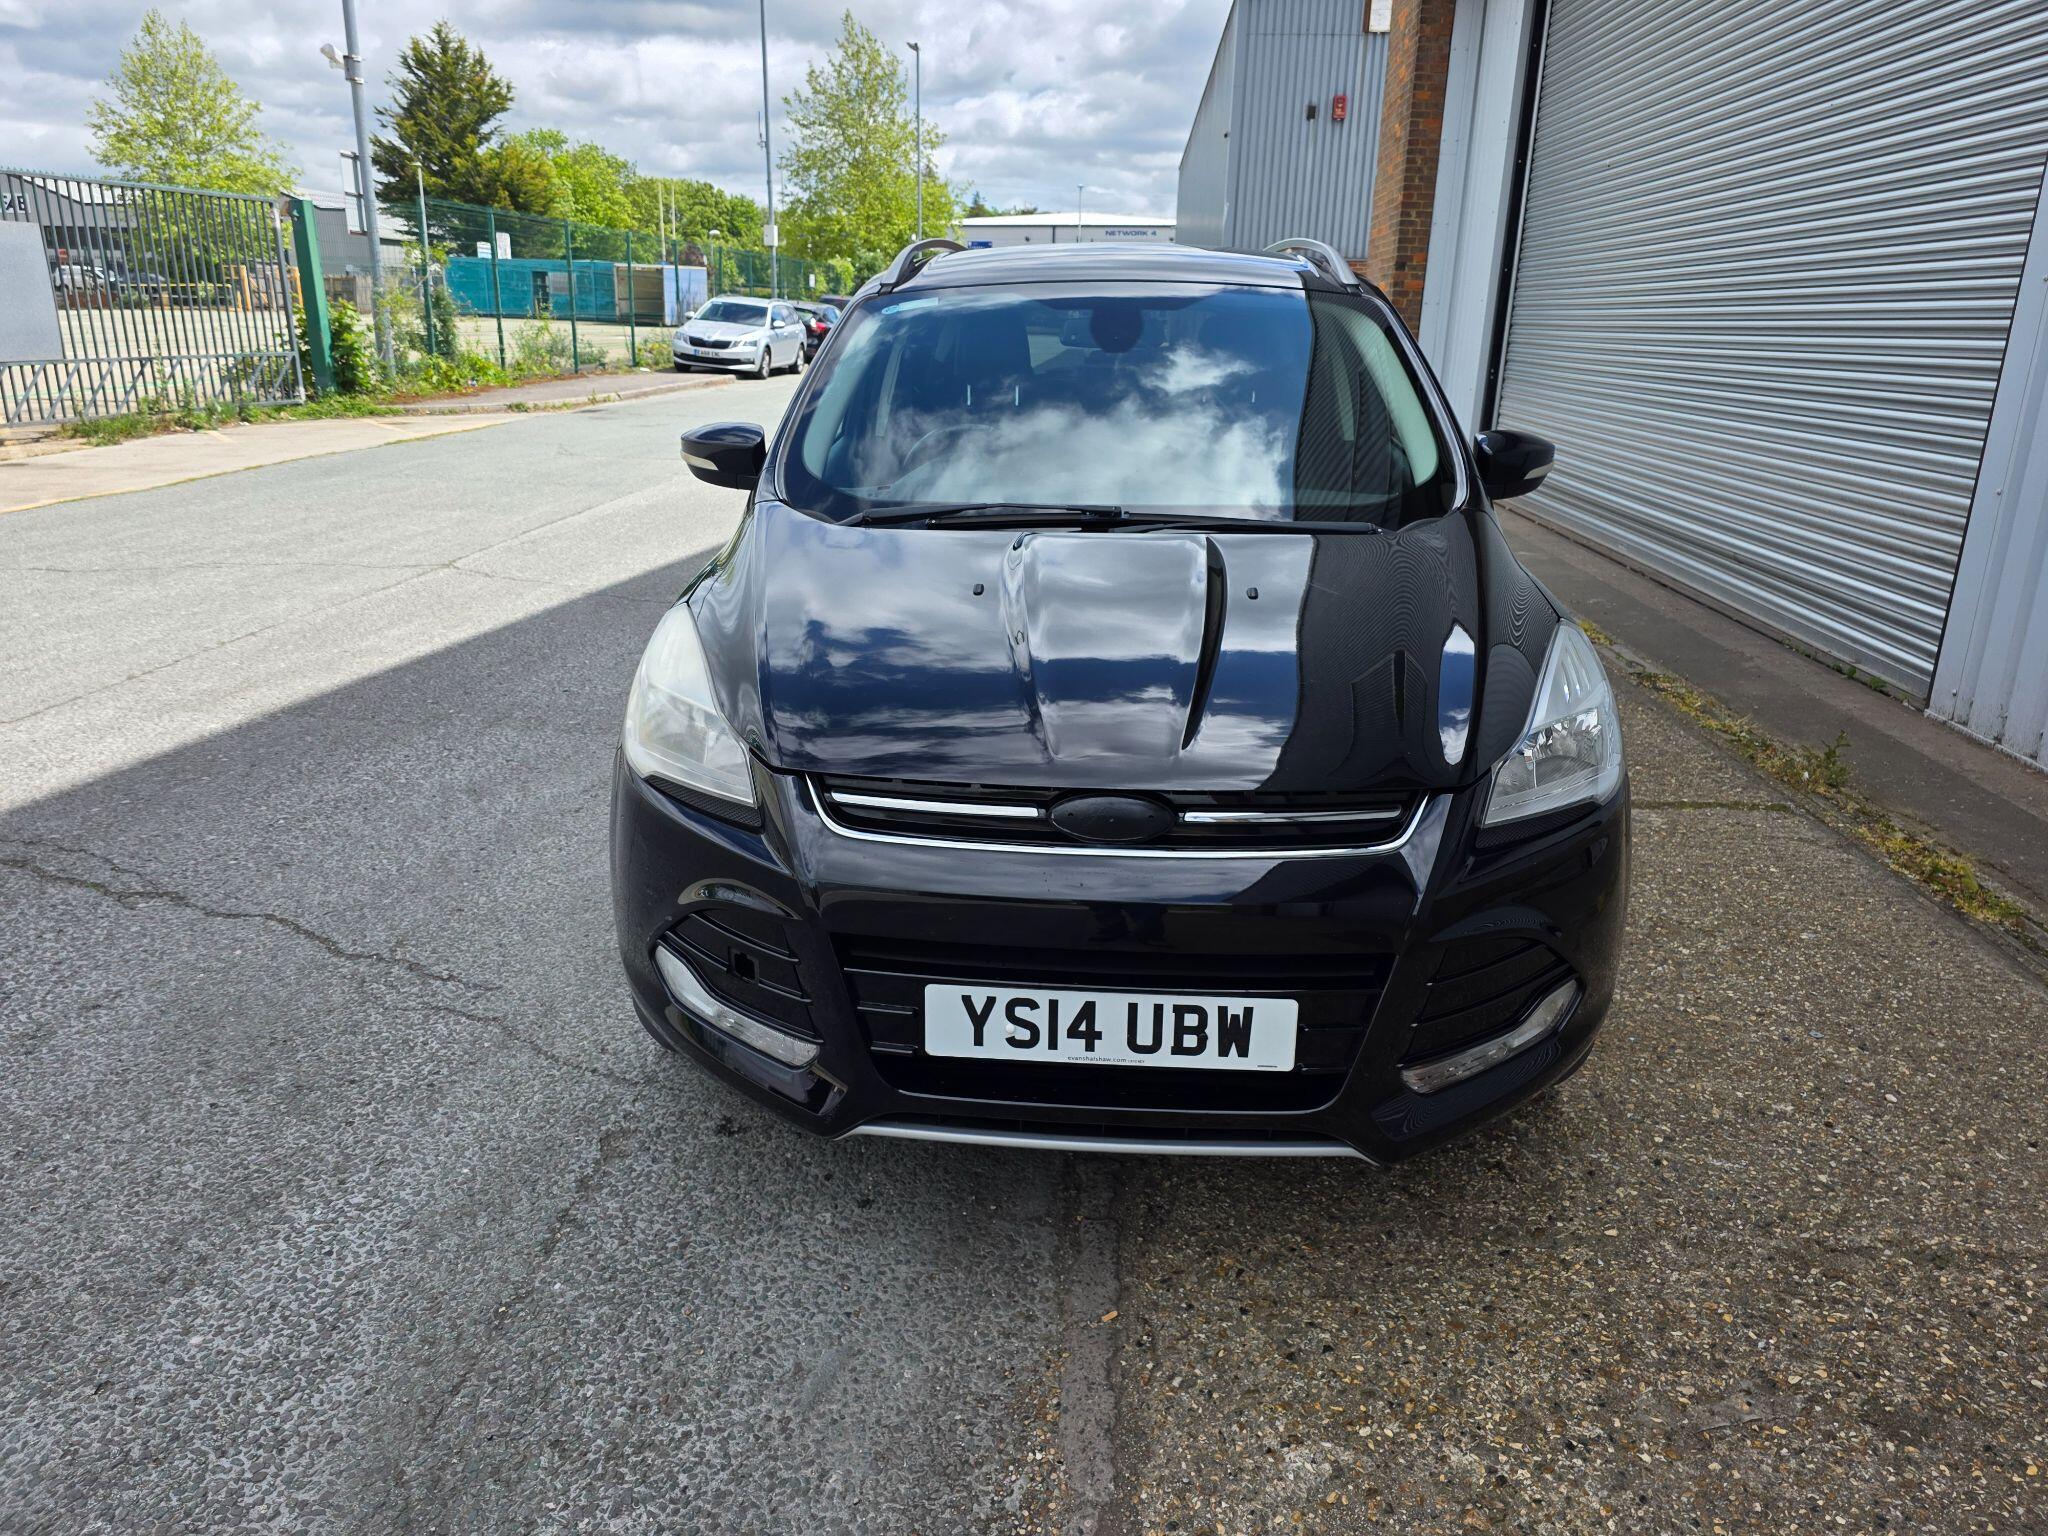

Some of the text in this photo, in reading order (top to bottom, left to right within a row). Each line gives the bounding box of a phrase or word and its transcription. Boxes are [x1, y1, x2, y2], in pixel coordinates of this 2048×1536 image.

[961, 994, 1255, 1059] YS14 UBW
[1067, 1055, 1127, 1063] evanshalshaw.com
